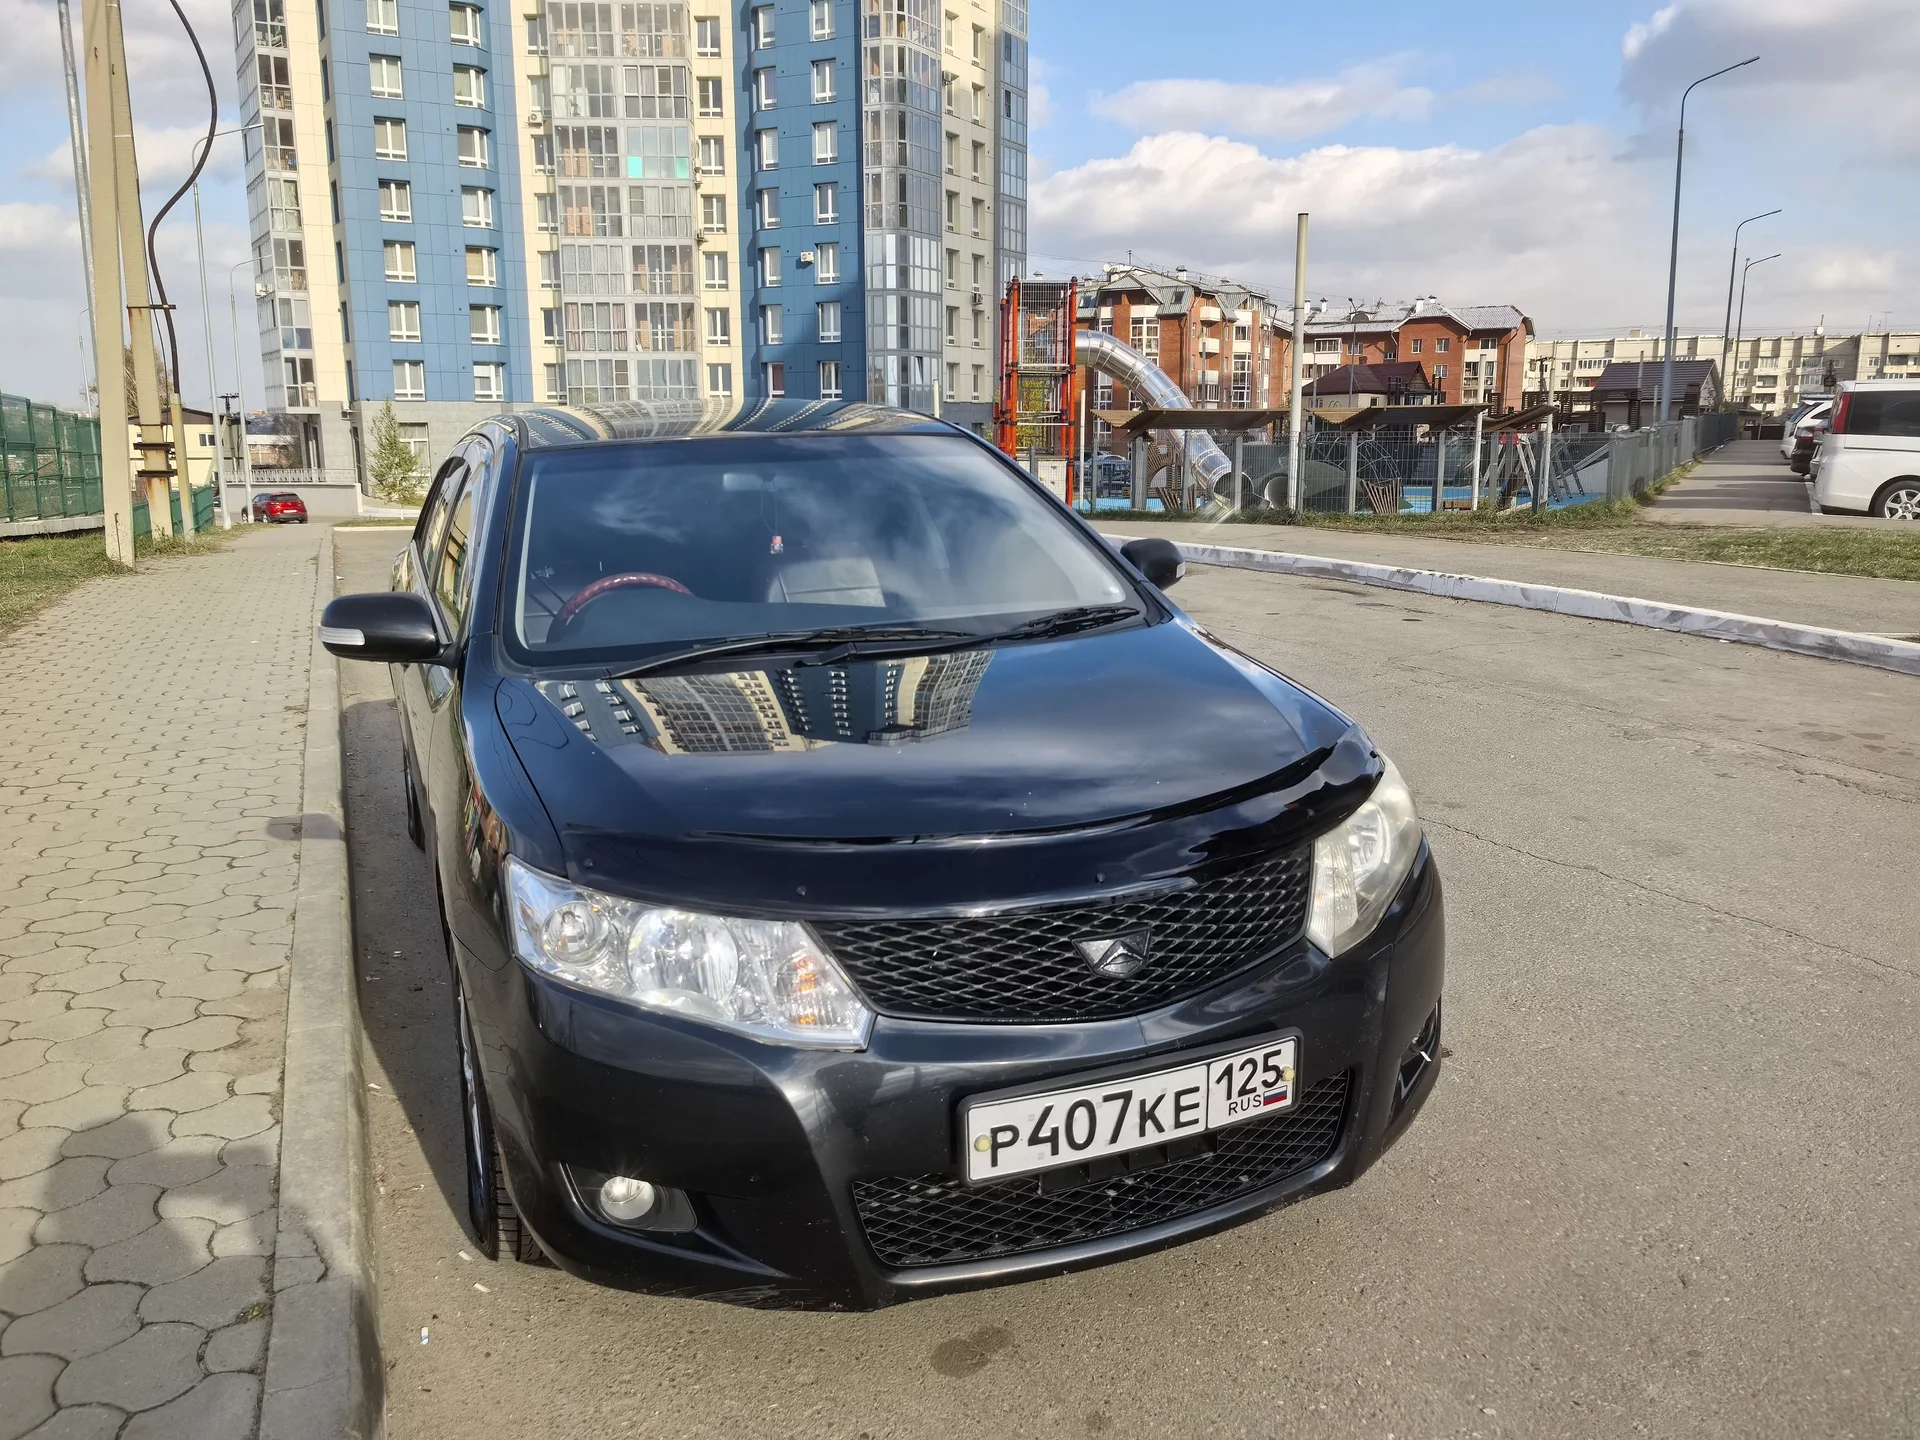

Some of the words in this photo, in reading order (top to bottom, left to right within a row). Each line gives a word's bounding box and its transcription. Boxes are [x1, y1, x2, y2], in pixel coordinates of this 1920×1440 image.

[990, 1086, 1200, 1167] P407KE
[1215, 1049, 1282, 1101] 125
[1229, 1094, 1262, 1116] RUS
